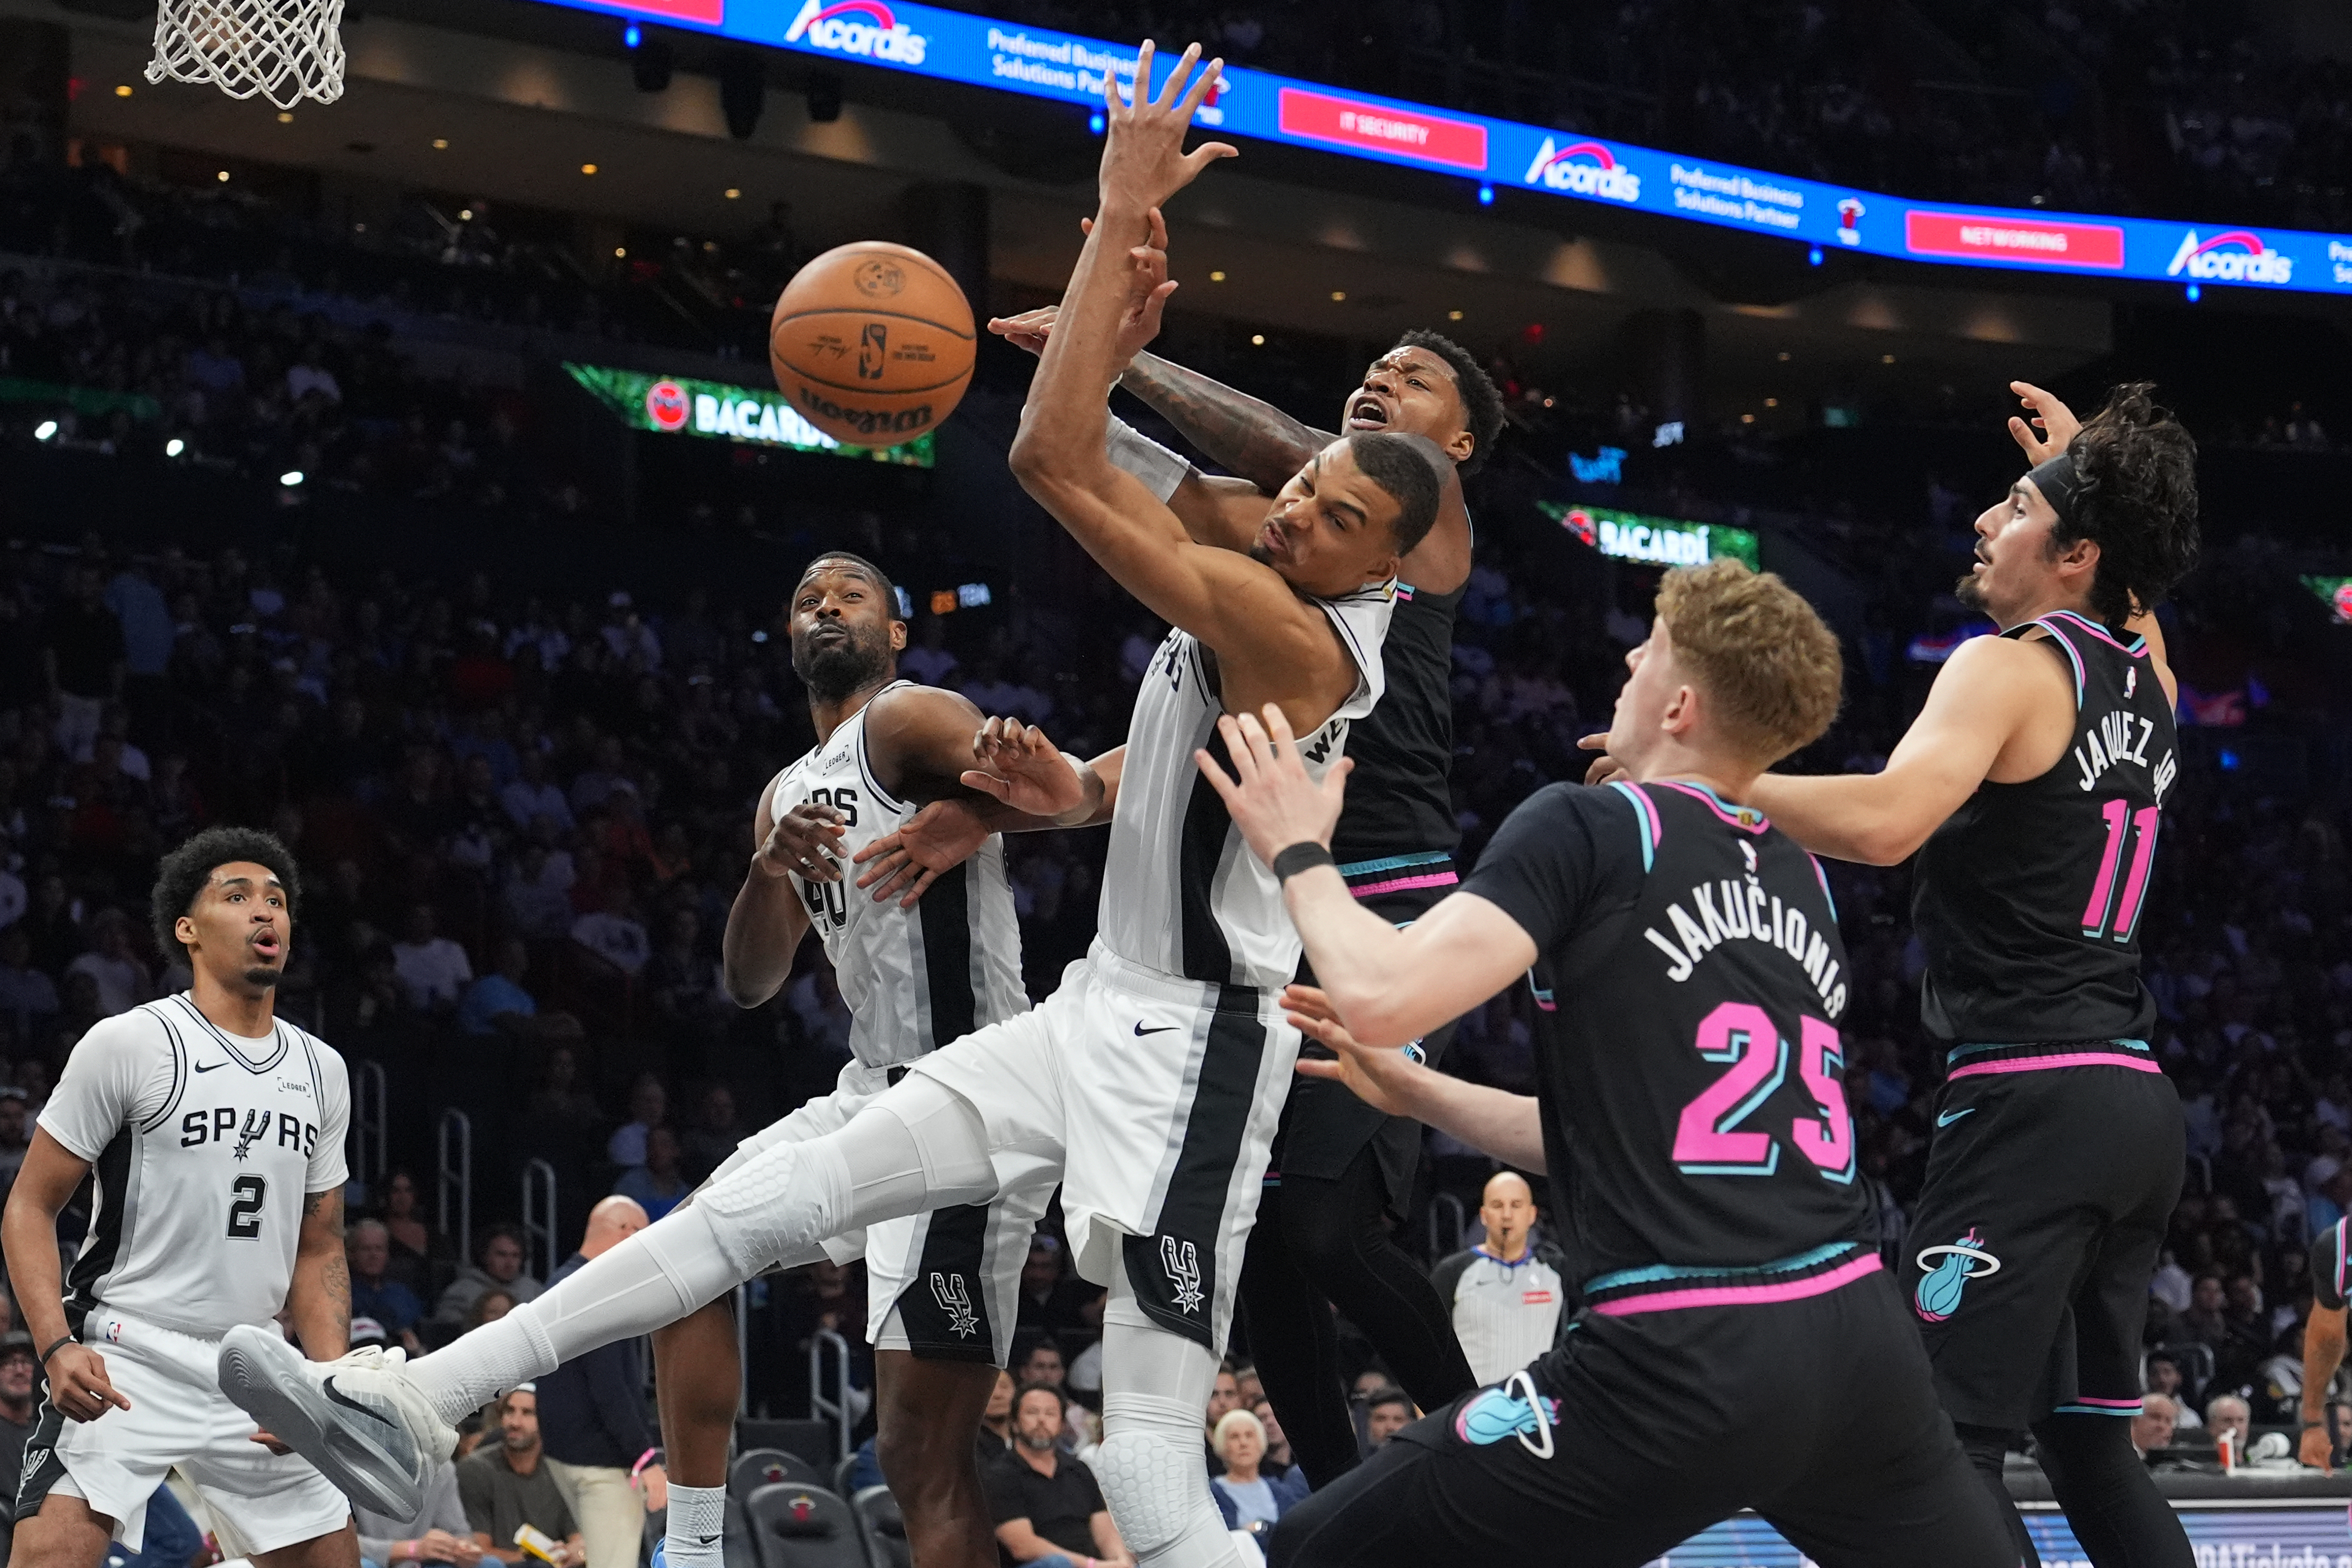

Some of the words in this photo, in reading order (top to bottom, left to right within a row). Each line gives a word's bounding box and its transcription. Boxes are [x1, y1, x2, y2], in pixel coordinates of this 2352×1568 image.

[784, 0, 926, 65] Acordis
[987, 27, 1072, 65] Preferred
[992, 53, 1077, 89] Solutions
[1340, 110, 1357, 132] IT
[1357, 114, 1430, 145] SECURITY
[1525, 136, 1641, 202] Acordis
[1671, 163, 1740, 197] Preferred
[1741, 177, 1804, 209] Business
[1674, 187, 1744, 219] Solutions
[1744, 201, 1800, 230] Partner
[1960, 225, 2069, 252] NETWORKING
[2167, 229, 2292, 284] Acordis
[826, 751, 845, 769] LEDGER
[2075, 711, 2154, 792] JAQUEZ
[2081, 799, 2160, 943] 11
[1644, 873, 1846, 1019] JAKUČIONIS
[282, 1081, 307, 1093] LEDGER
[1672, 1001, 1856, 1185] 25
[180, 1108, 319, 1163] SPURS
[226, 1172, 268, 1240] 2
